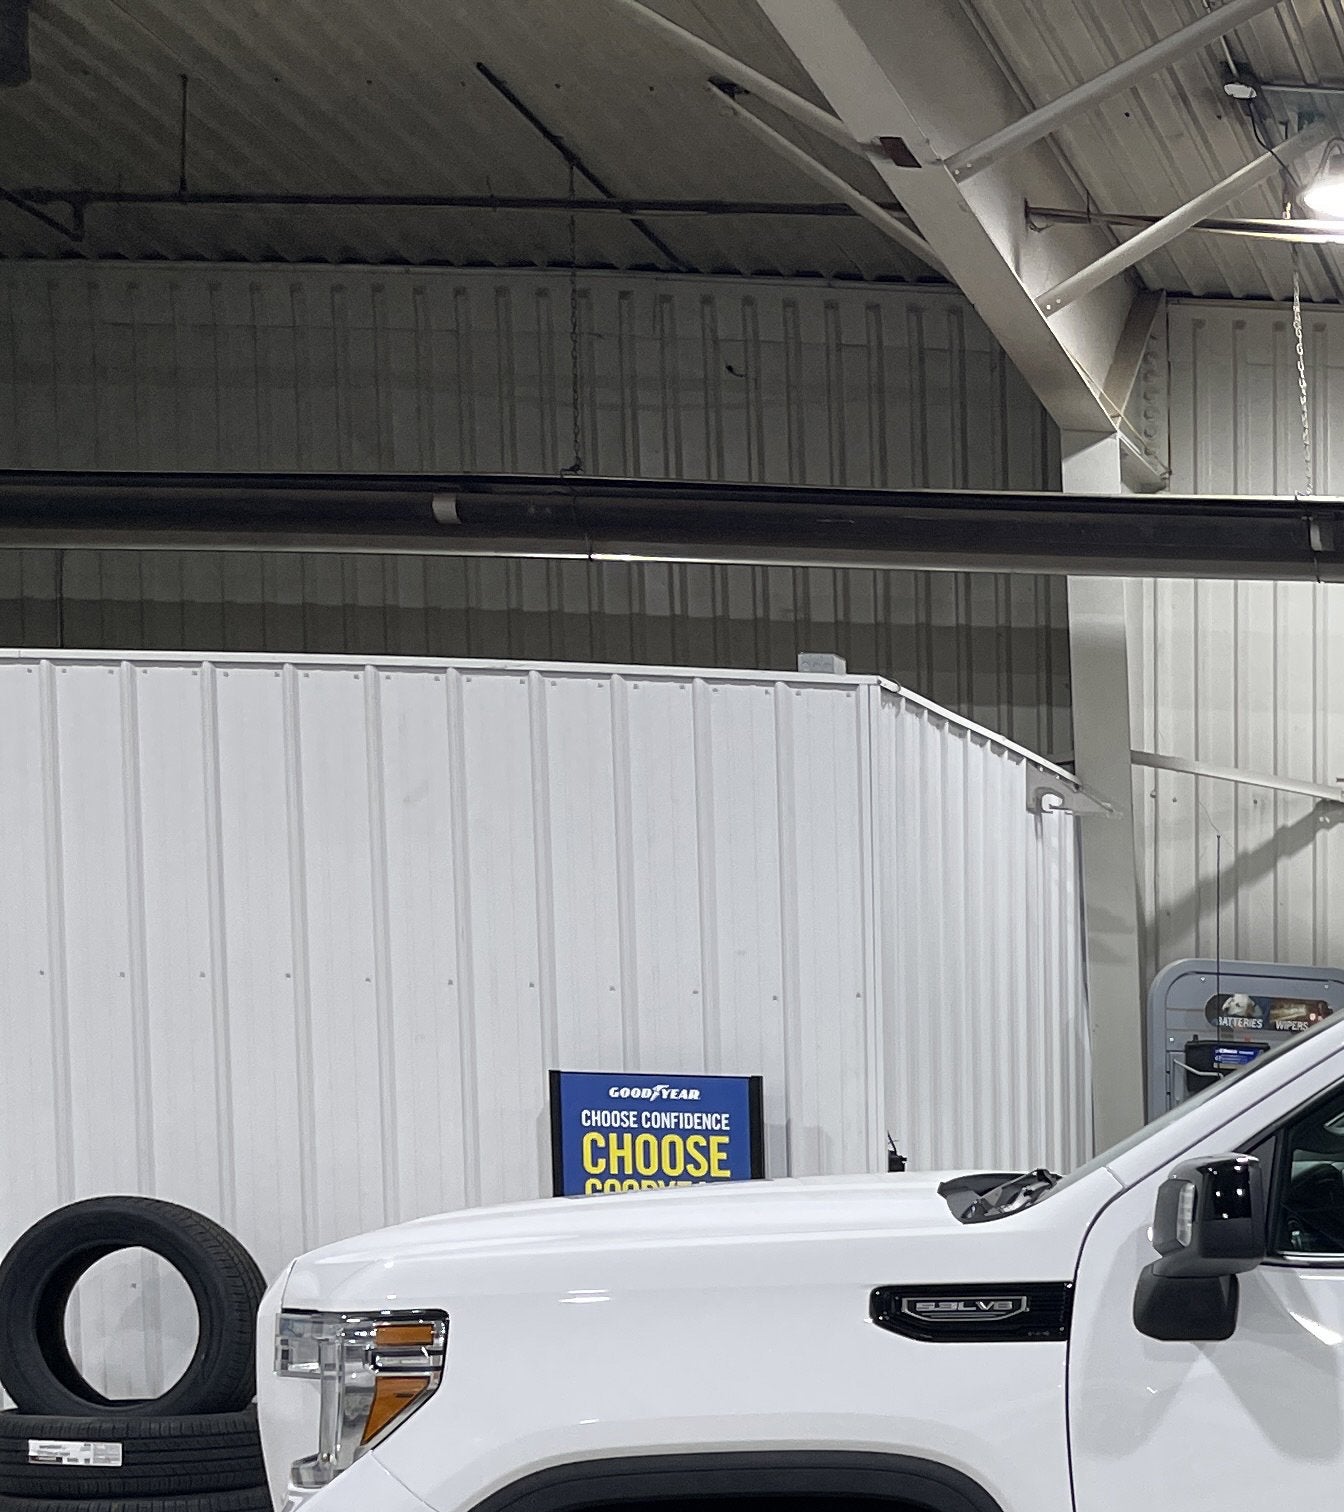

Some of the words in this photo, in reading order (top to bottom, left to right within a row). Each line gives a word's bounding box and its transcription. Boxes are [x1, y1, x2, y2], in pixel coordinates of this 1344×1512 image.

[1219, 1017, 1263, 1028] BATTERIES
[1275, 1020, 1308, 1030] WIPERS
[609, 1084, 700, 1101] GOODYEAR
[582, 1110, 638, 1128] CHOOSE
[642, 1112, 730, 1130] CONFIDENCE
[583, 1132, 731, 1178] CHOOSE
